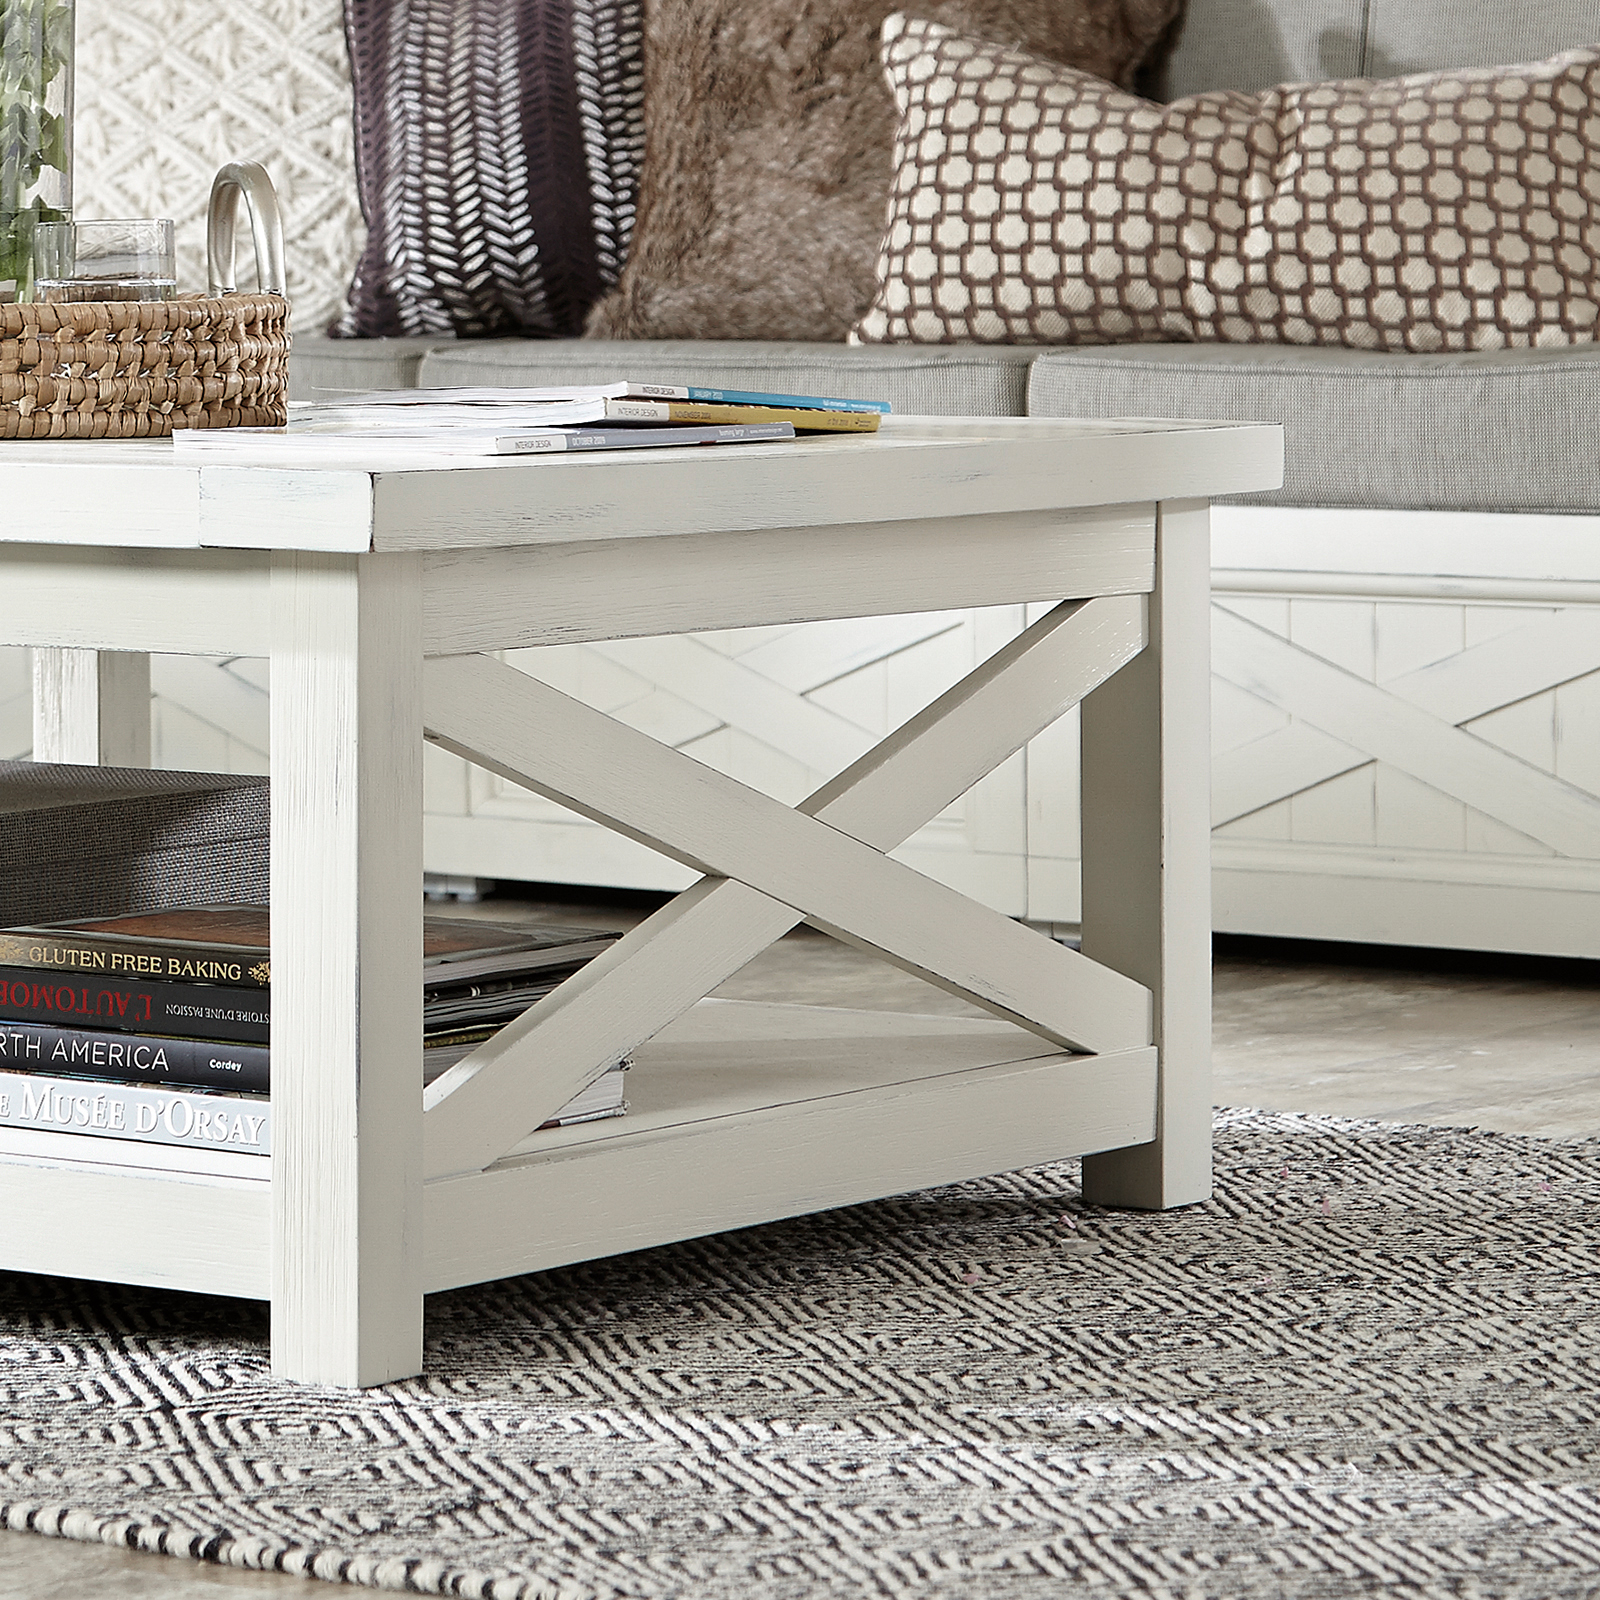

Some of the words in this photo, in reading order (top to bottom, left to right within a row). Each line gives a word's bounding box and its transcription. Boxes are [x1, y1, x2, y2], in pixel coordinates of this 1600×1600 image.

[617, 406, 638, 416] INTERIOR
[639, 408, 659, 418] DESIGN
[514, 439, 535, 449] INTERIOR
[535, 438, 552, 448] DESIGN
[29, 946, 105, 969] GLUTEN
[110, 953, 163, 974] FREE
[168, 958, 242, 980] BAKING
[165, 1004, 204, 1018] PASSION
[205, 1007, 235, 1021] D'UNE
[51, 1039, 170, 1072] AMERICA
[209, 1058, 243, 1073] Cordey
